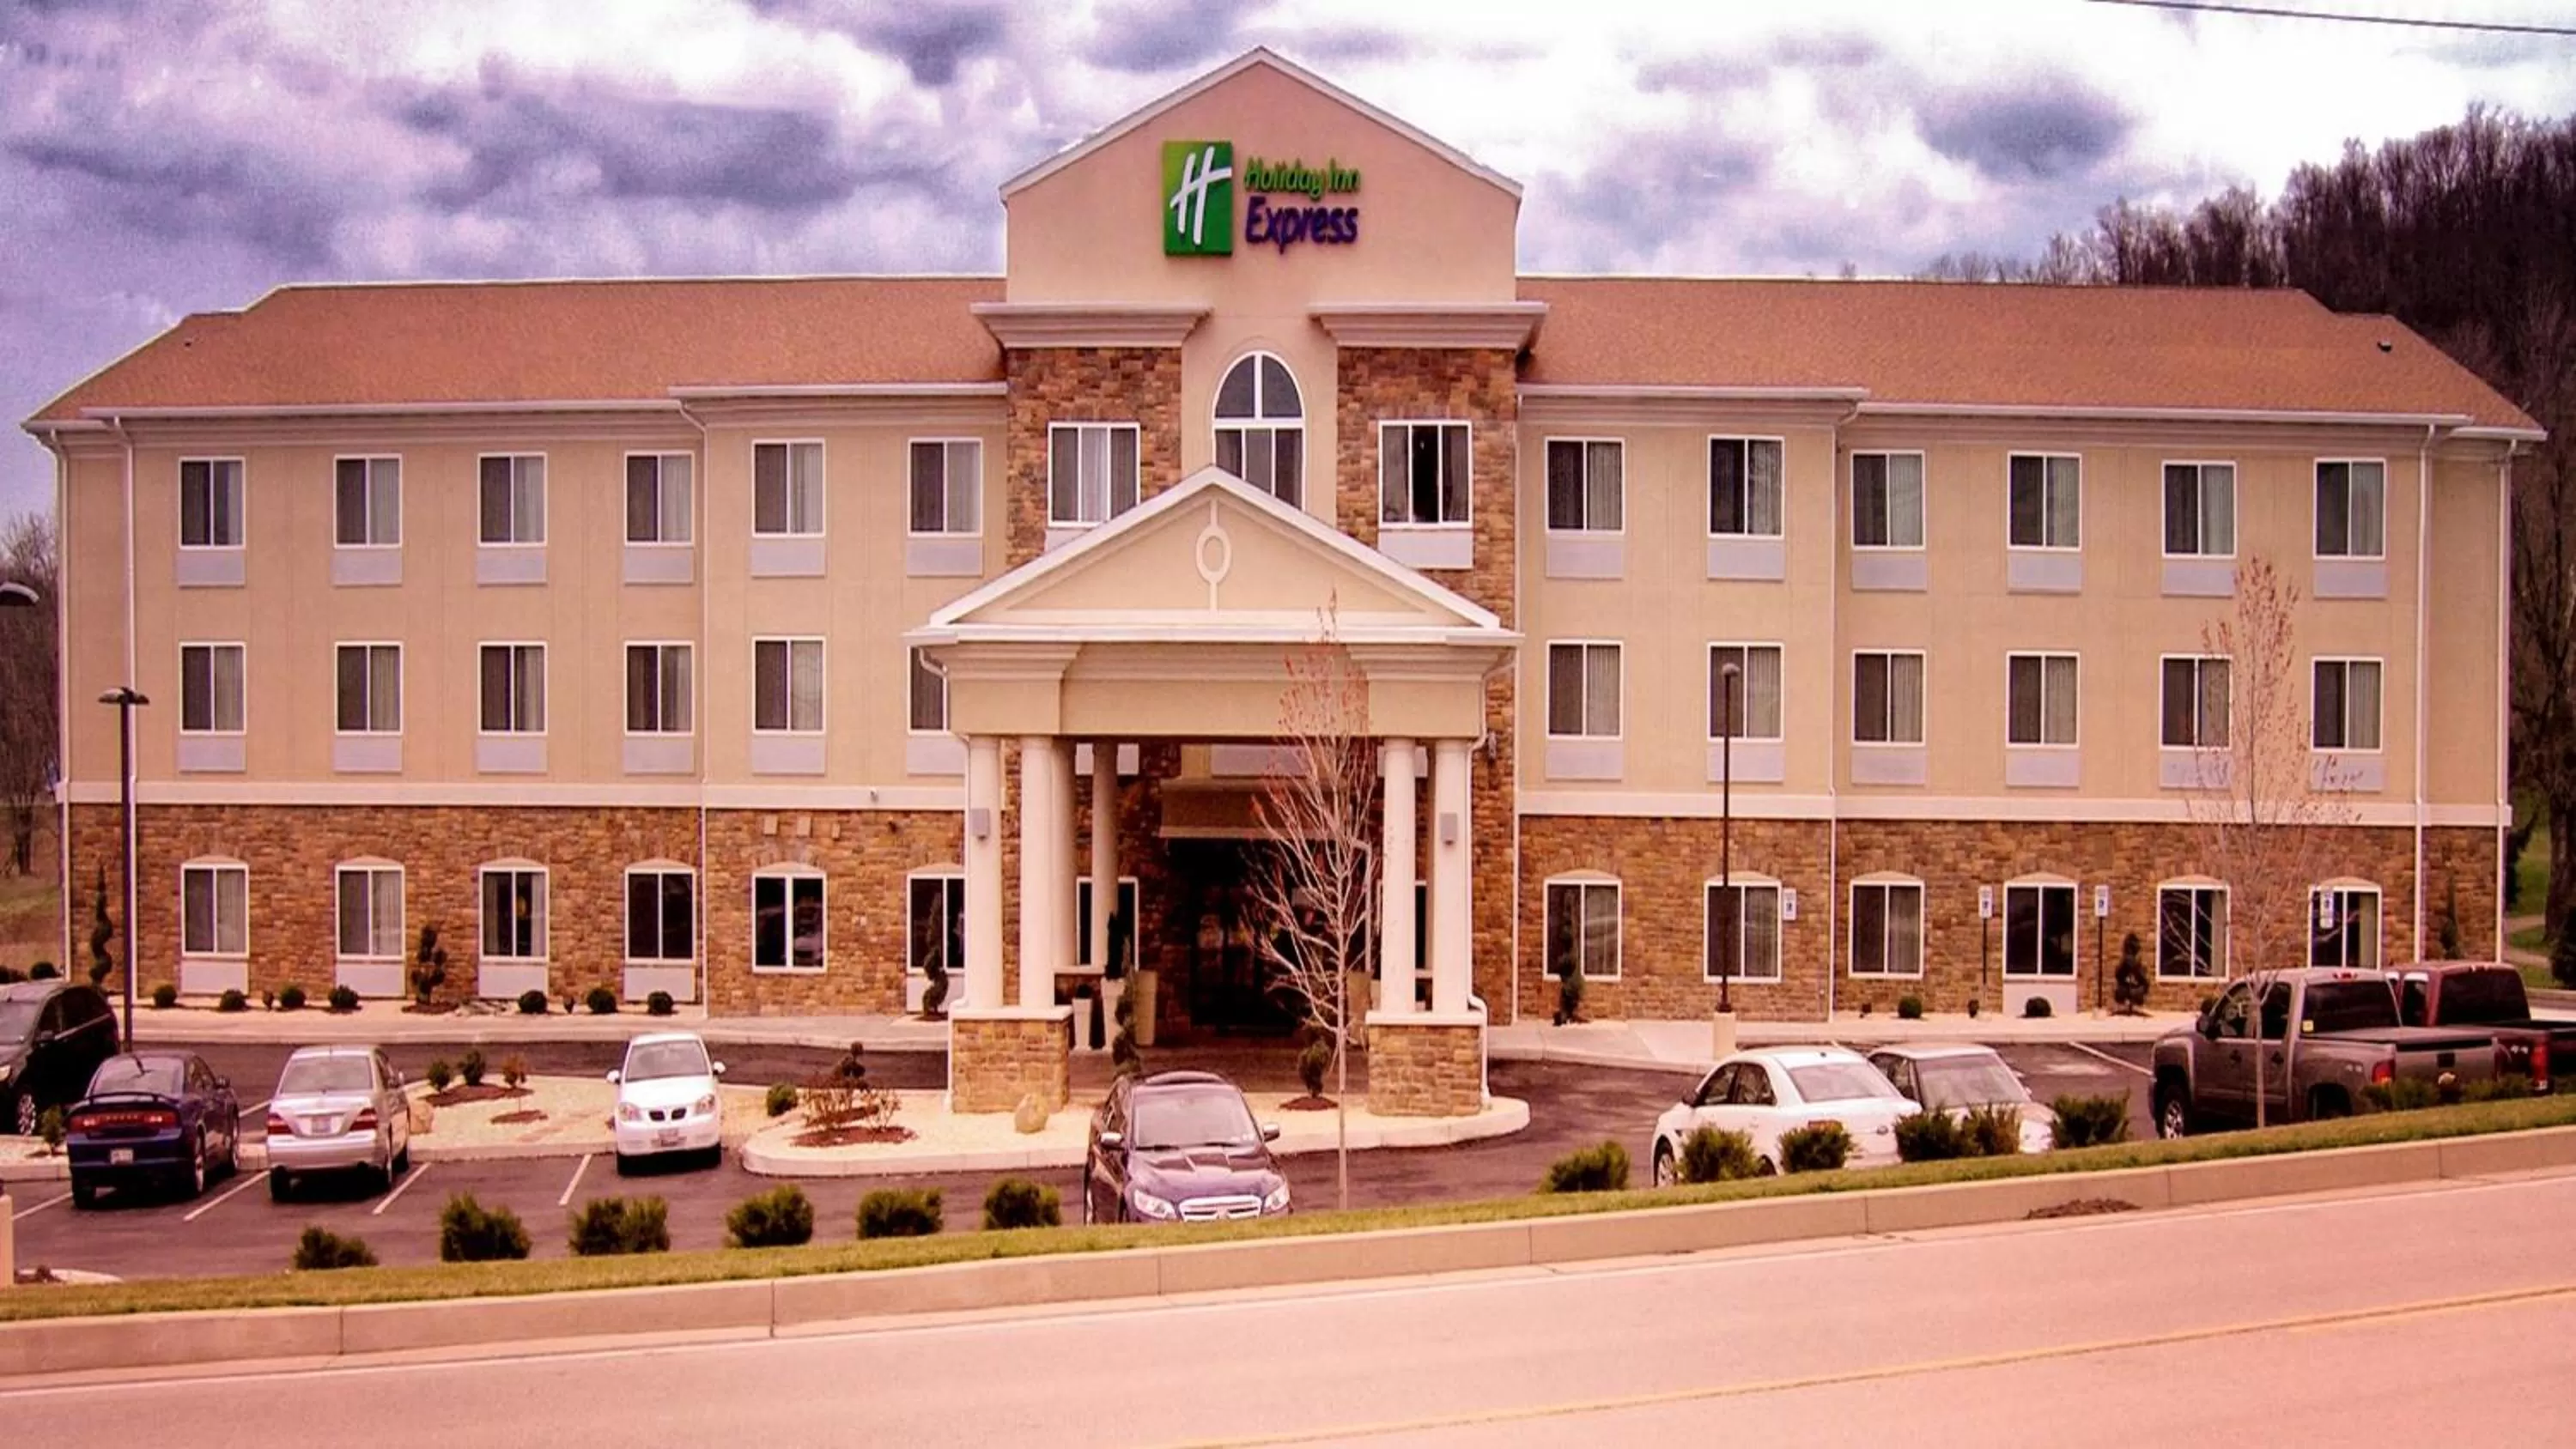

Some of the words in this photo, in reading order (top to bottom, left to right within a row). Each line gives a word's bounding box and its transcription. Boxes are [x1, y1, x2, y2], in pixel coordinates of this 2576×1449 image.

[1244, 156, 1326, 200] Holiday
[1328, 157, 1360, 191] Inn
[1246, 196, 1359, 254] Express
